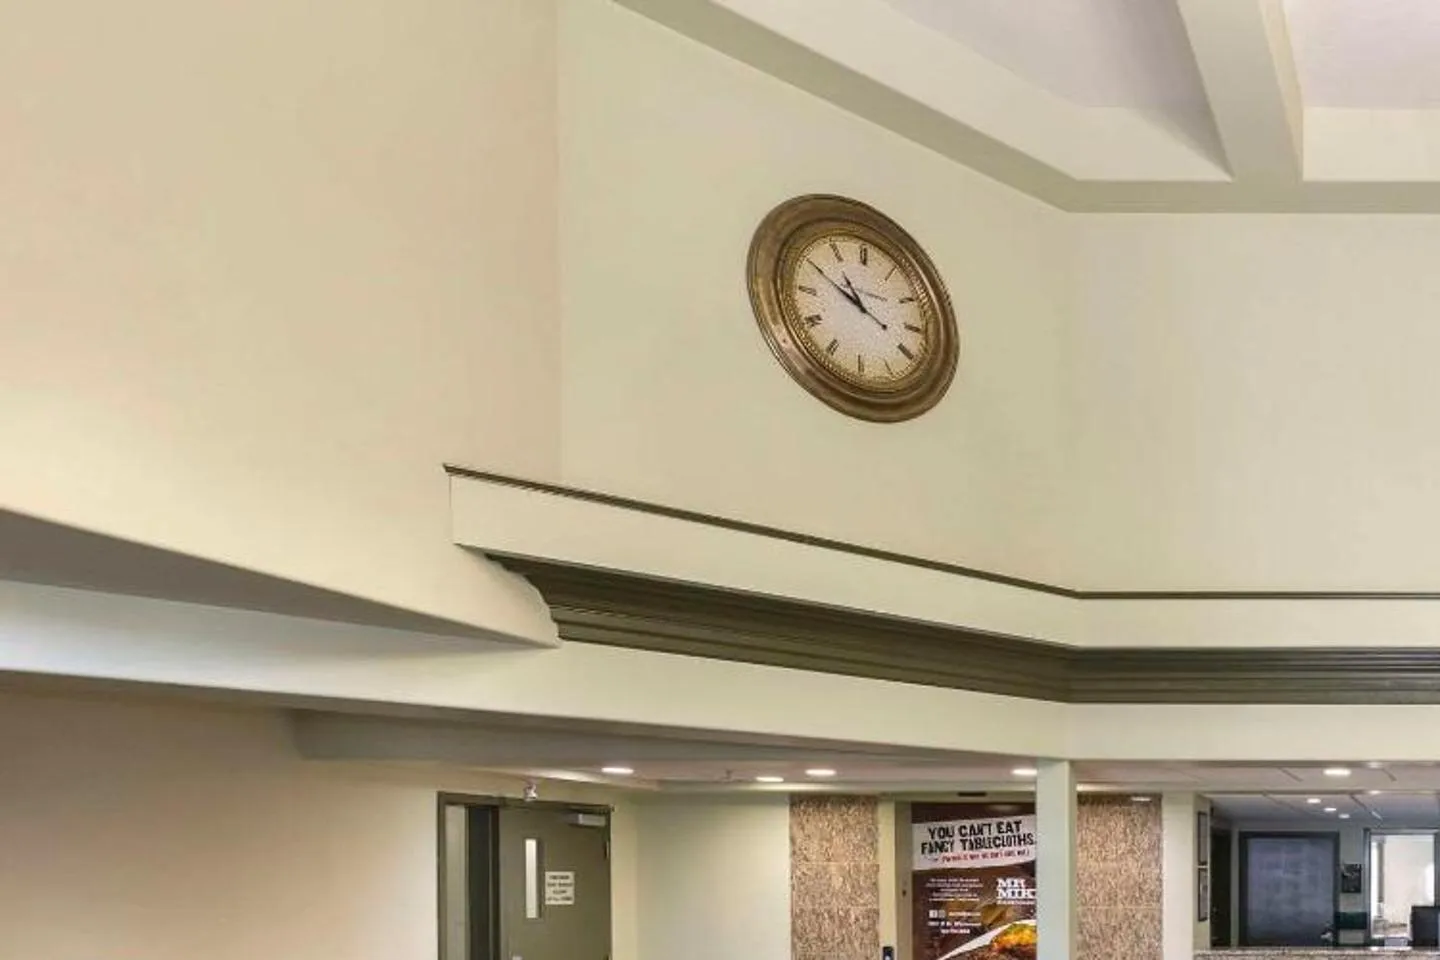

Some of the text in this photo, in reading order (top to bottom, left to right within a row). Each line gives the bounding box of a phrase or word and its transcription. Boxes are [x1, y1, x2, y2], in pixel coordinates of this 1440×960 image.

[928, 827, 955, 840] YOU
[996, 819, 1022, 834] EAT
[996, 888, 1037, 899] MIK
